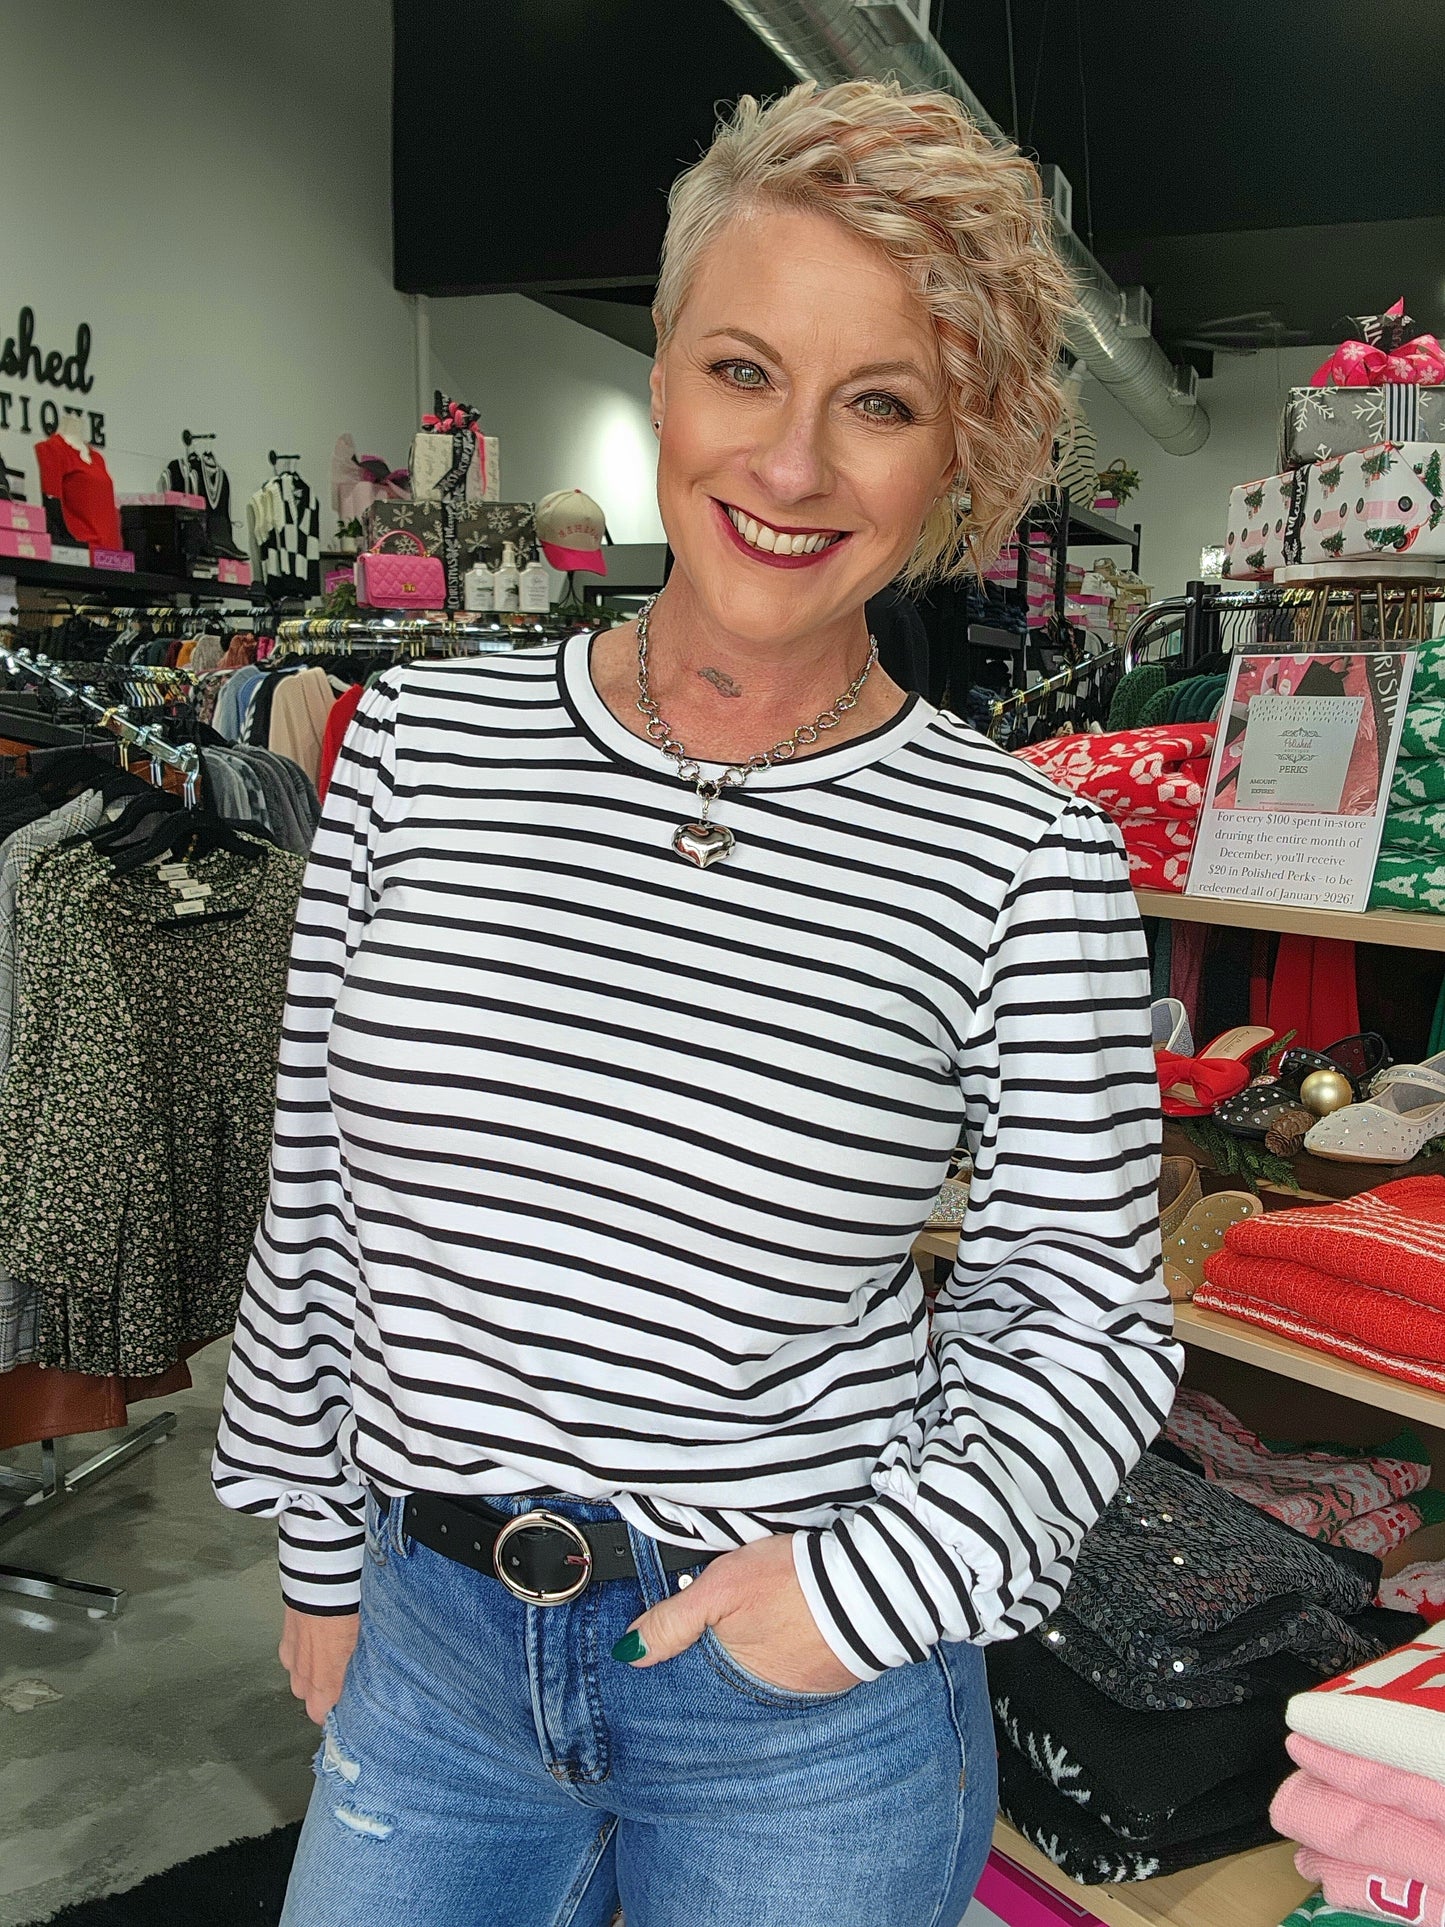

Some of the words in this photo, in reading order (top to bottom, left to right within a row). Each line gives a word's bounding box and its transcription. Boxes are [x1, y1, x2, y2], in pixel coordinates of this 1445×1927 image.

[0, 391, 105, 447] TIQE
[1284, 738, 1313, 749] Polished
[1278, 765, 1308, 774] PERKS
[1217, 811, 1235, 822] For
[1236, 815, 1263, 827] every
[1266, 813, 1290, 825] $100
[1292, 815, 1321, 829] spent
[1324, 817, 1367, 829] in-store
[1256, 831, 1273, 843] the
[1276, 834, 1308, 845] entire
[1310, 836, 1346, 848] month
[1349, 838, 1363, 848] of
[1219, 847, 1273, 861] December,
[1307, 856, 1346, 866] receive
[1208, 864, 1226, 875] $20
[1229, 866, 1238, 876] in
[1241, 866, 1285, 880] Polished
[1287, 869, 1316, 882] Perks
[1325, 874, 1336, 884] to
[1339, 874, 1353, 885] be
[1199, 883, 1248, 895] redeemed
[1250, 886, 1264, 897] all
[1266, 887, 1280, 898] of
[1276, 888, 1320, 904] January
[1323, 892, 1354, 905] 2026!
